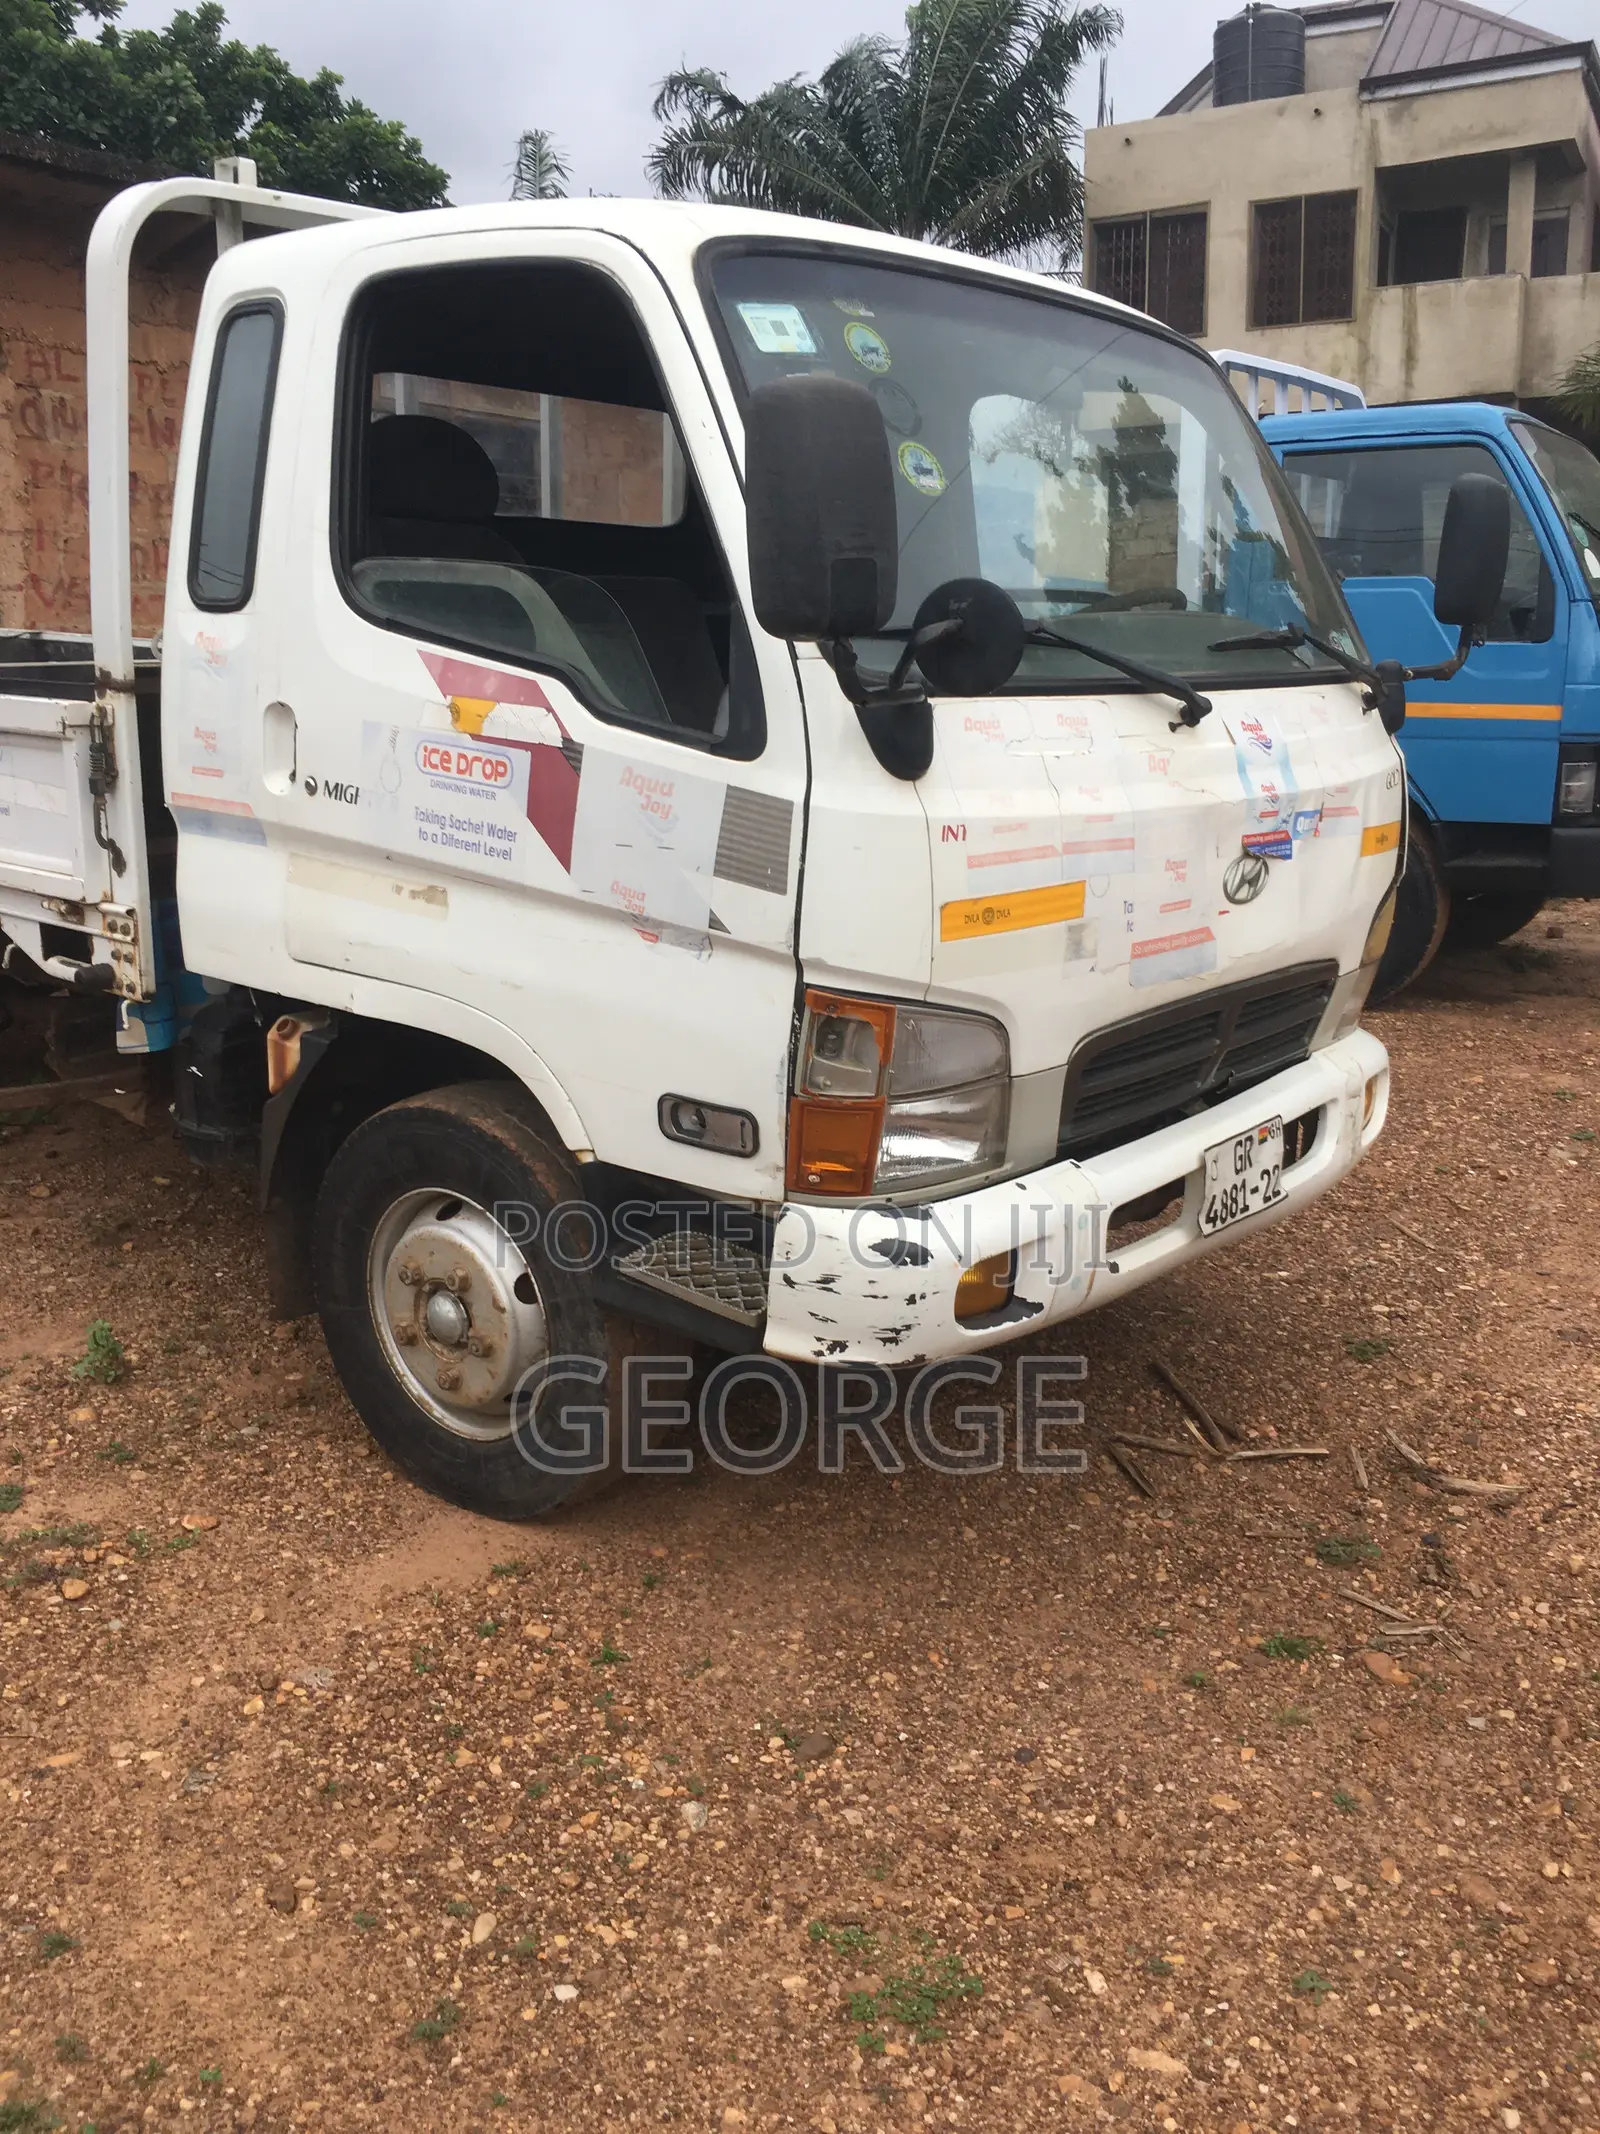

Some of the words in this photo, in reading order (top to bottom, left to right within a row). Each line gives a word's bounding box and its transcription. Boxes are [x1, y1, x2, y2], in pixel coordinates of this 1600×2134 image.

[430, 779, 467, 795] DRINKING
[469, 788, 497, 800] WATER
[619, 766, 675, 798] Aqua
[640, 794, 672, 820] Joy
[414, 806, 446, 830] Taking
[449, 814, 484, 836] Sachet
[487, 822, 517, 843] Water
[418, 827, 428, 841] to
[431, 833, 438, 844] a
[484, 842, 512, 861] Level
[611, 880, 646, 902] Aqua
[625, 899, 645, 915] Joy
[964, 914, 980, 925] DVLA
[996, 908, 1011, 920] DVLA
[1233, 1135, 1254, 1175] GR
[1269, 1120, 1282, 1139] GH
[1205, 1164, 1281, 1228] 4881-22
